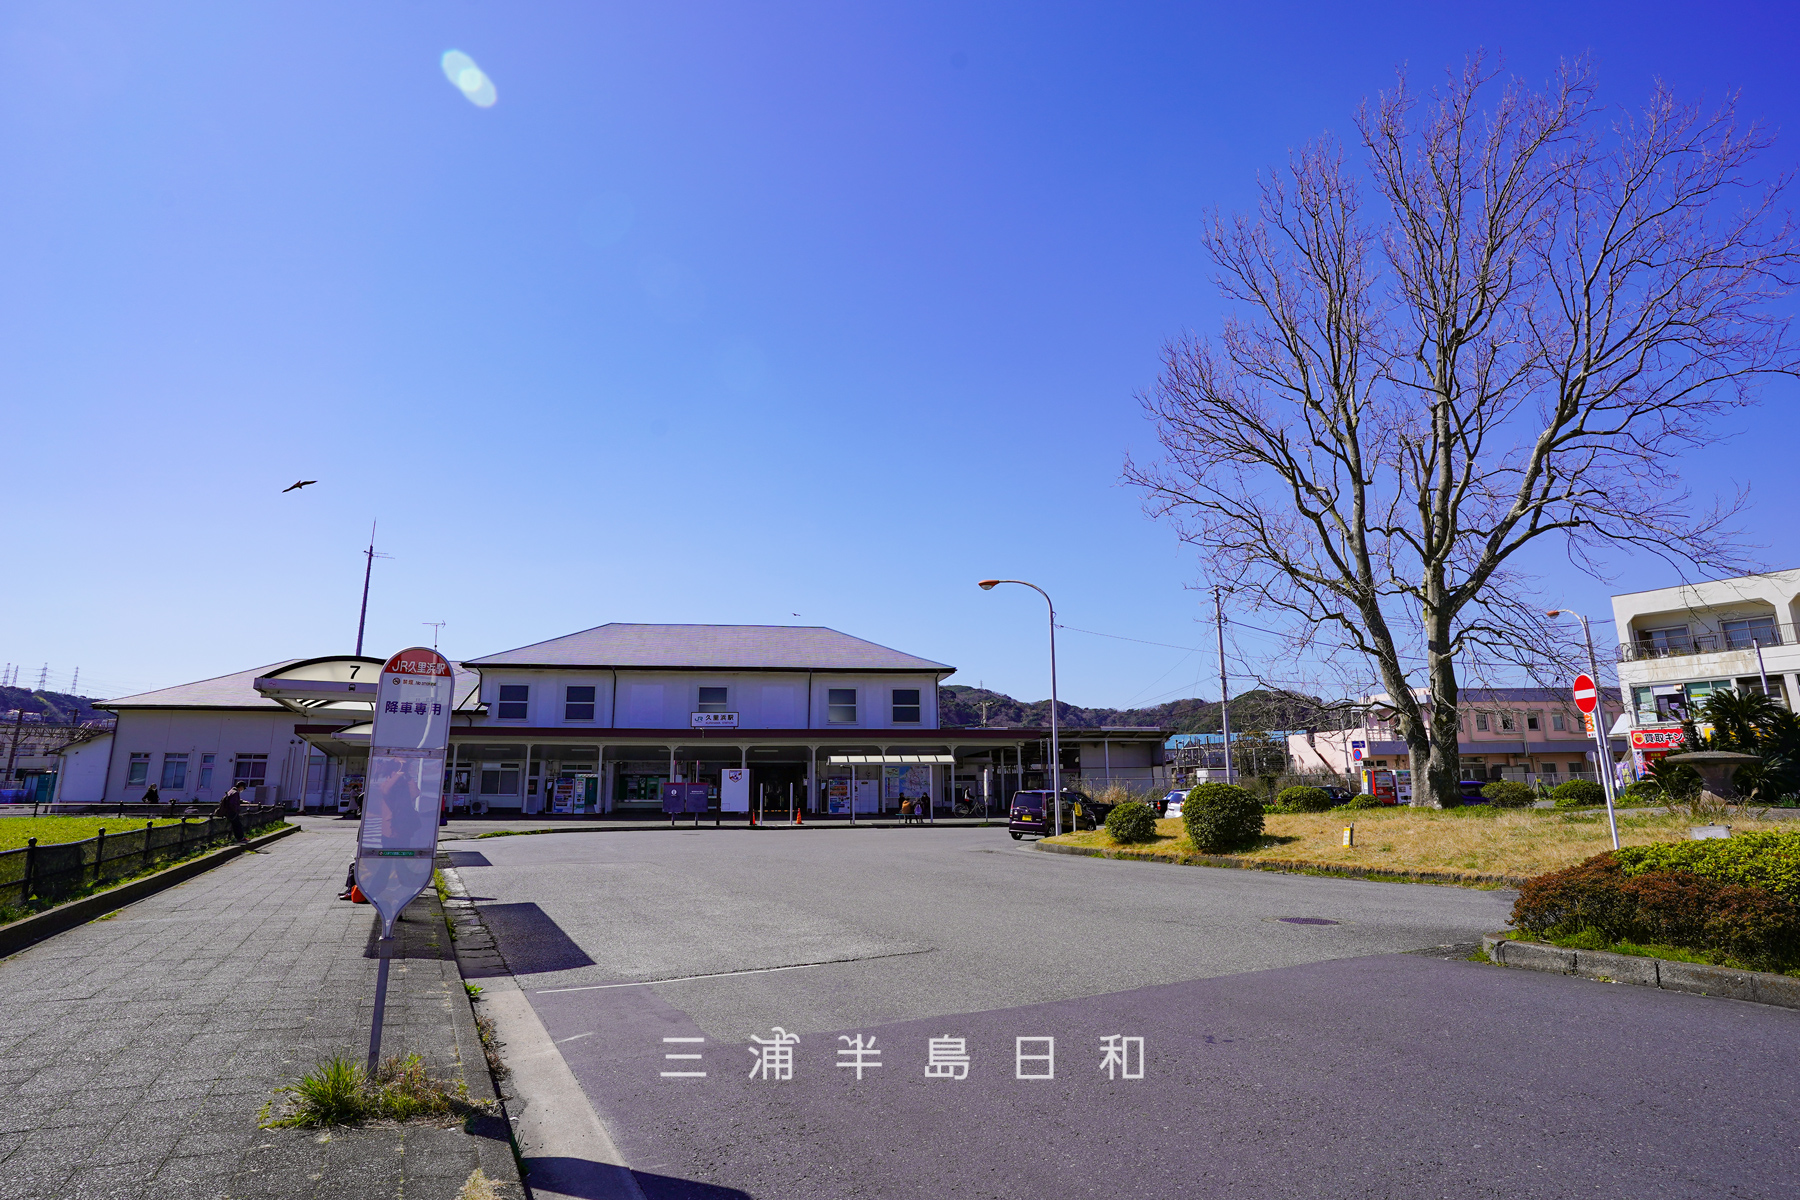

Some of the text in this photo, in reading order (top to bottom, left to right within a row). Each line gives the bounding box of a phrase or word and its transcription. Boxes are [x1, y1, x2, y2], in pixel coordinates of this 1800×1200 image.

[350, 665, 361, 679] 7
[392, 660, 446, 674] JR久里浜駅
[385, 701, 442, 715] 降車専用
[1644, 732, 1686, 743] 買取キン
